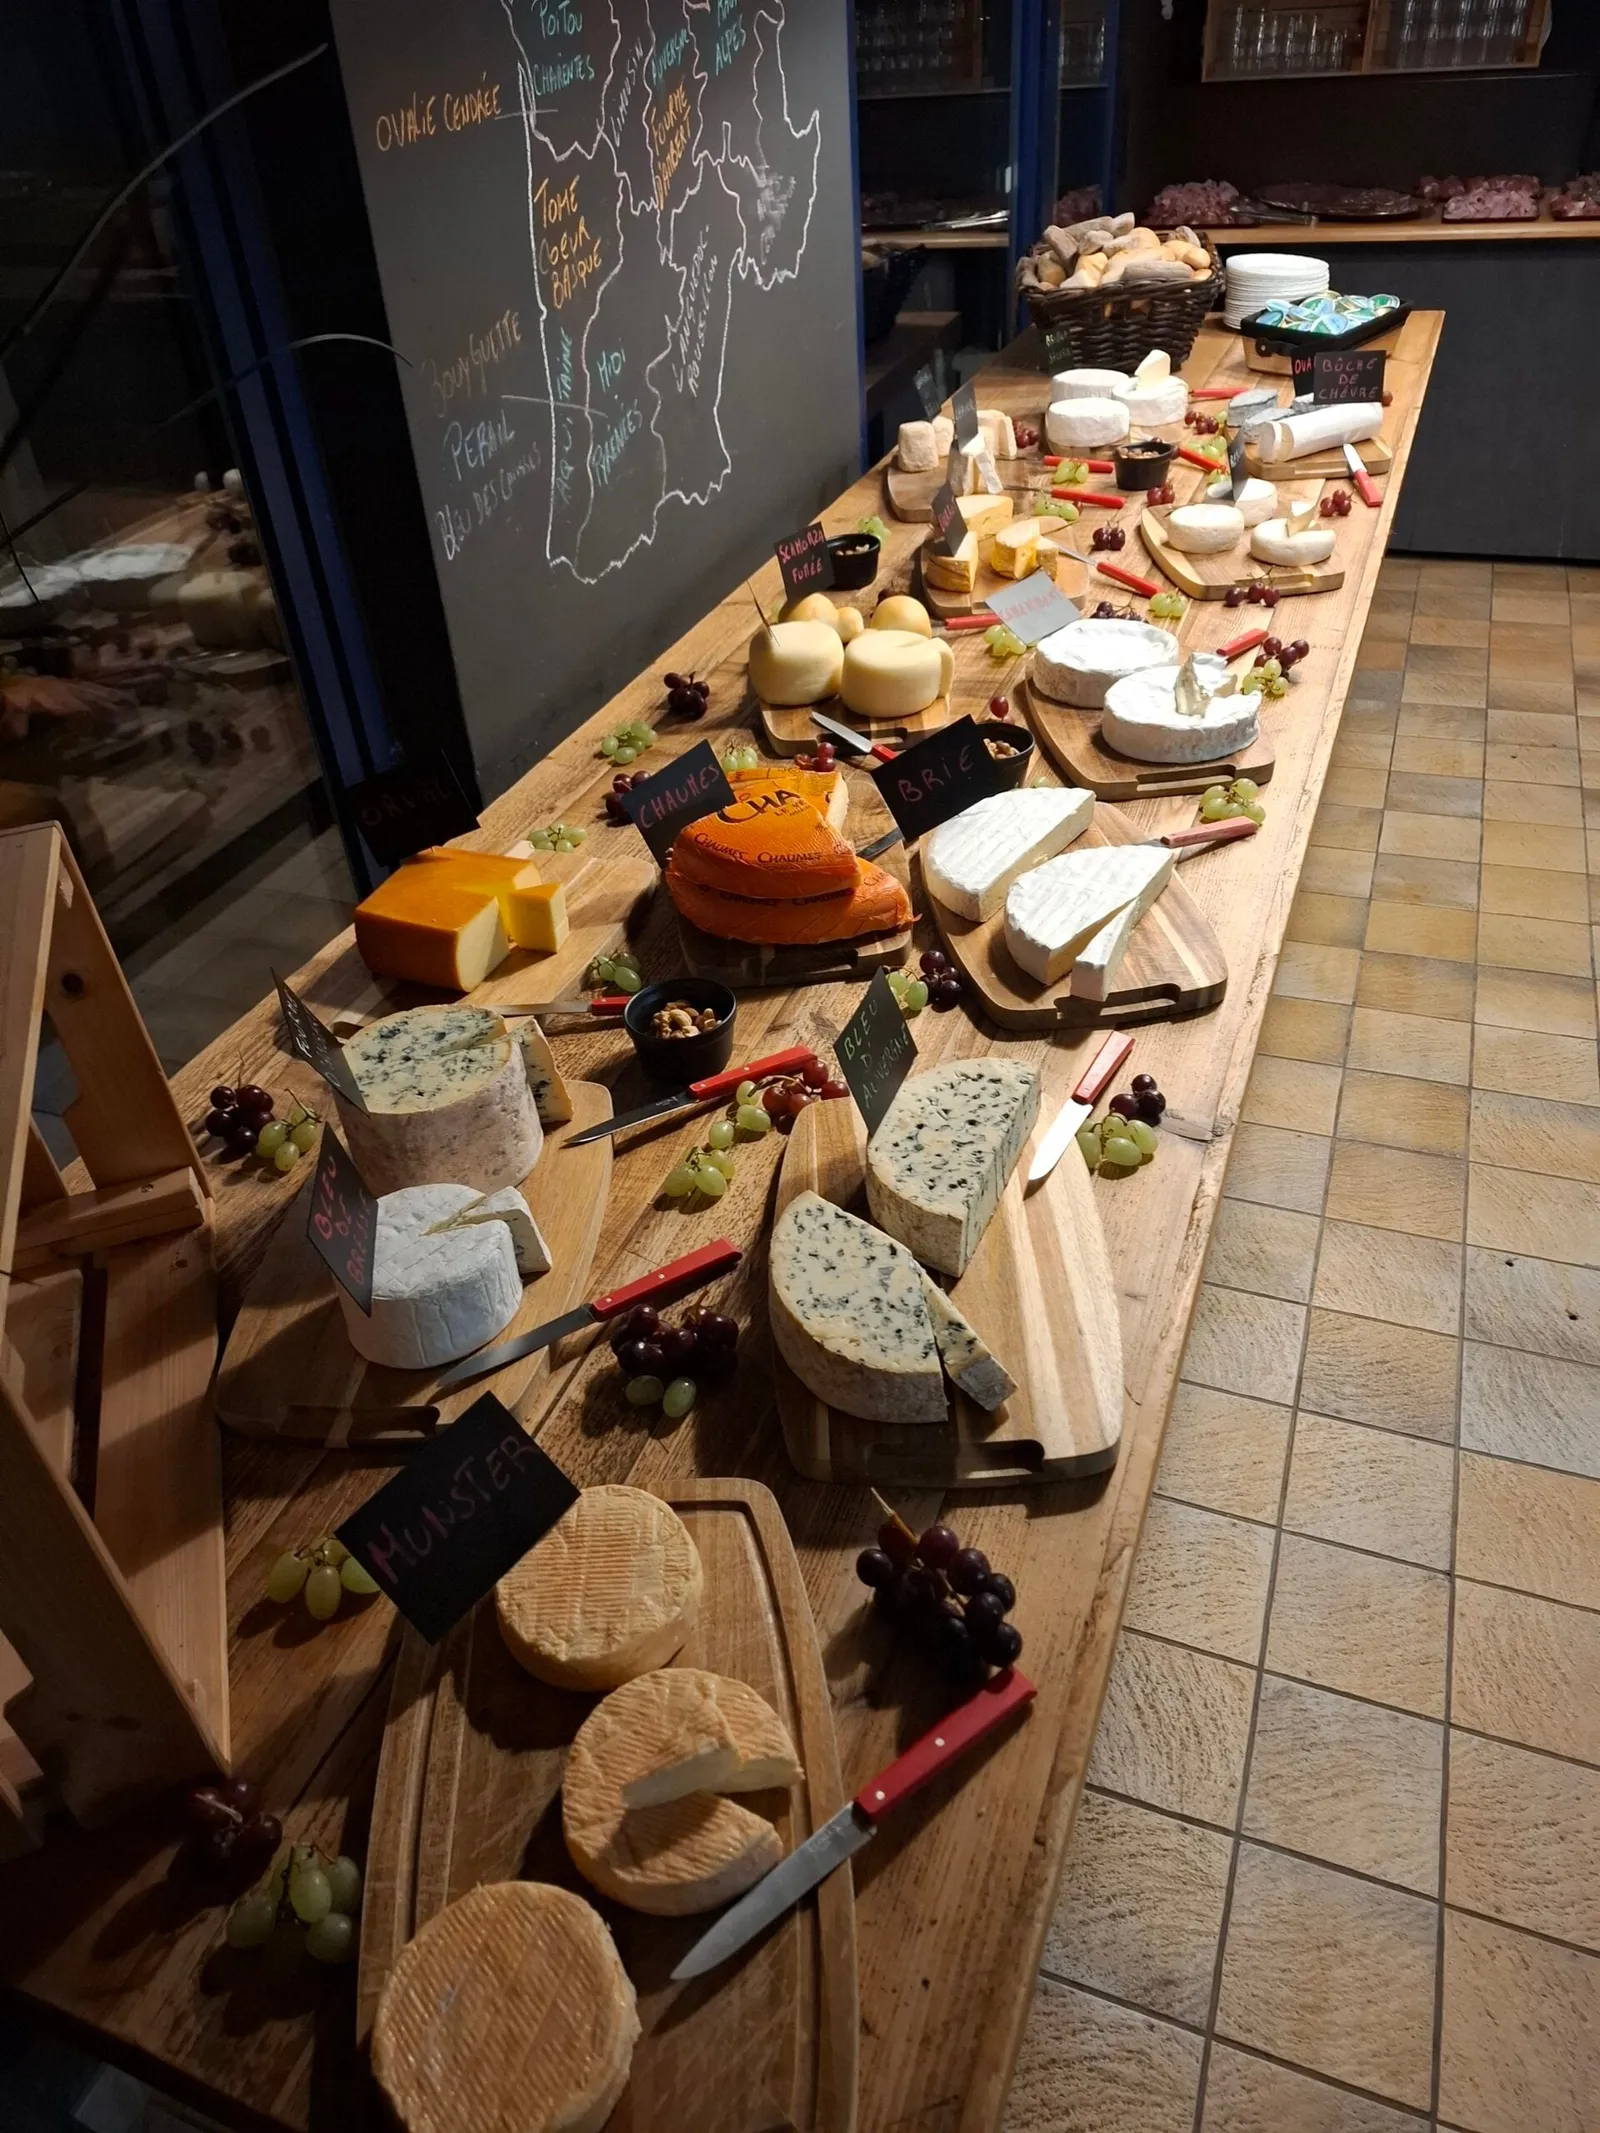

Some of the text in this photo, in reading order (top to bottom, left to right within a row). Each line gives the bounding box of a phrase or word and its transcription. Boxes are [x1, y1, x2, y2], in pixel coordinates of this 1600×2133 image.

[715, 13, 746, 76] ALPES
[534, 175, 580, 229] TOME
[540, 216, 590, 274] COEUR
[552, 236, 601, 309] BASQUE
[1339, 374, 1359, 384] DE
[640, 764, 719, 829] CHAUMES
[898, 744, 974, 802] BRIE
[694, 832, 822, 863] CHAUMES CHAUMES
[843, 999, 878, 1061] BLEU
[367, 1435, 536, 1585] MUNSTER
